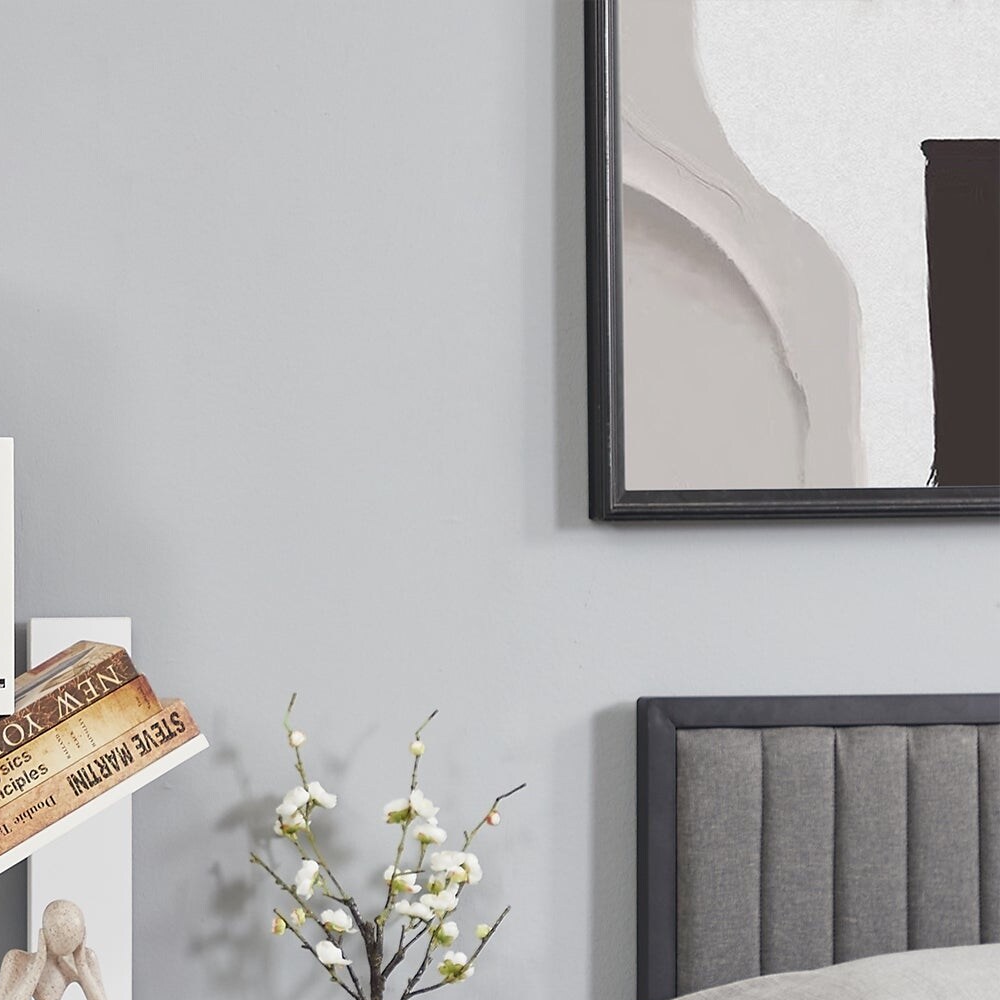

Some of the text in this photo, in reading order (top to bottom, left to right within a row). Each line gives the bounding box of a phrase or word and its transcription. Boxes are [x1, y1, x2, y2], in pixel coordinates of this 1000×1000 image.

[55, 664, 123, 719] NEW
[130, 711, 187, 758] STEVE
[66, 742, 134, 797] MARTINI
